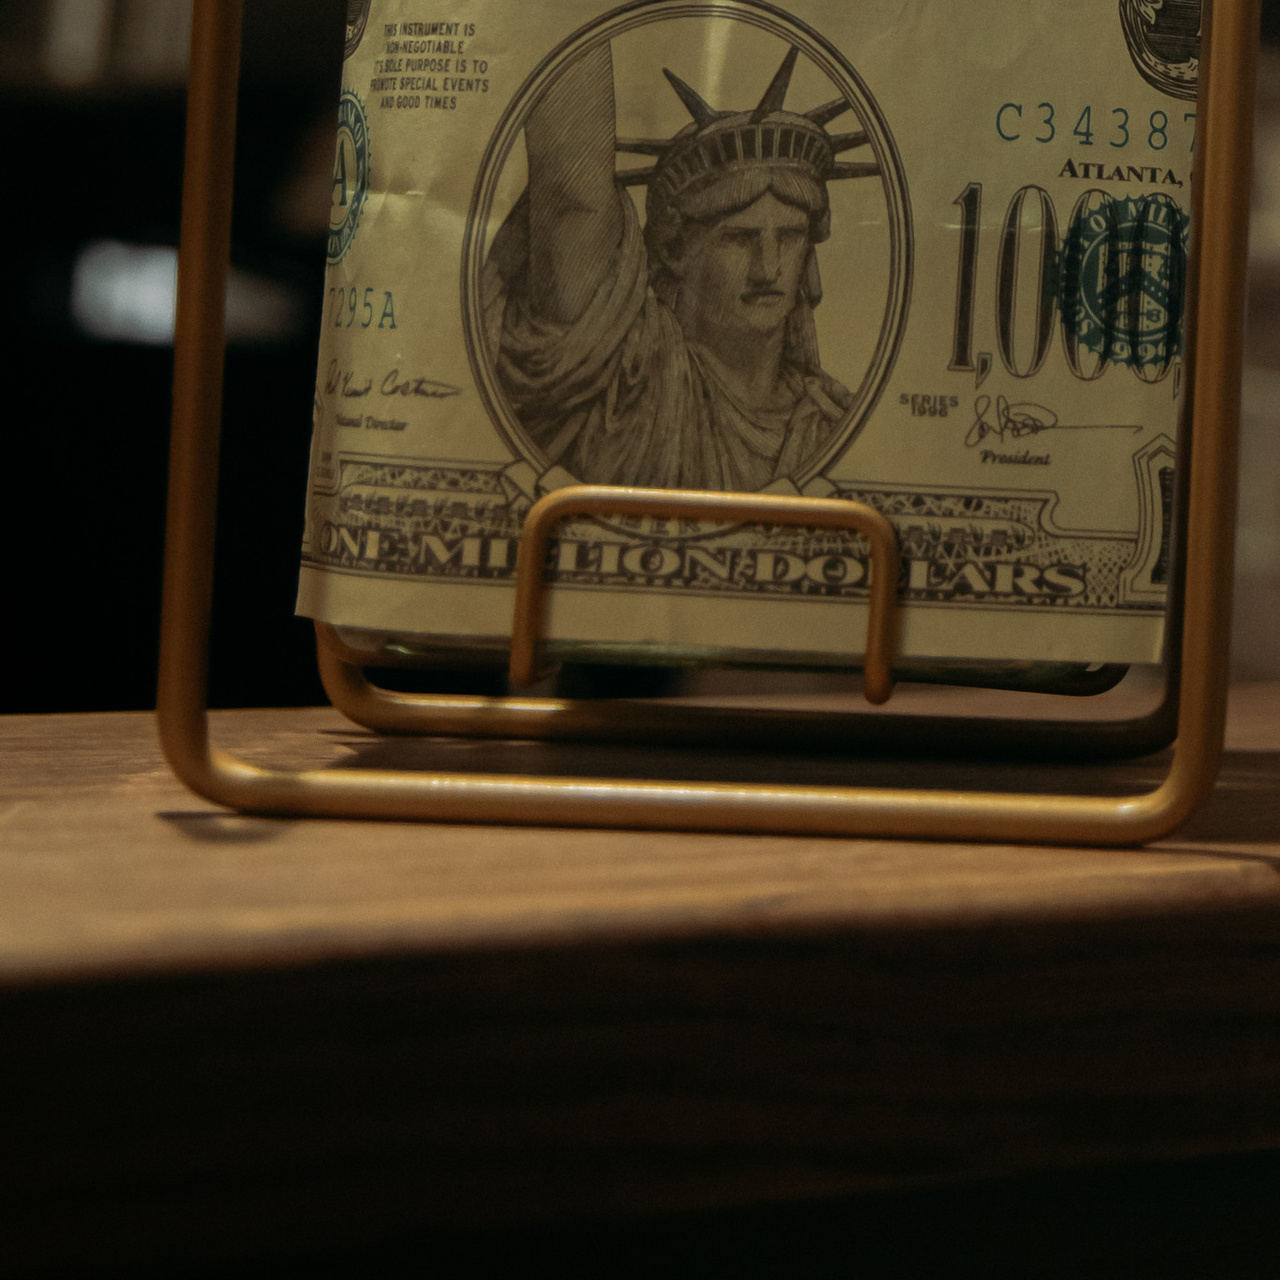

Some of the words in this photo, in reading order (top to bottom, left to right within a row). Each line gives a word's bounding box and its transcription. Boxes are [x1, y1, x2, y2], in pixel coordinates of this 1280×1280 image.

[384, 24, 398, 37] THIS
[400, 23, 459, 37] INSTRUMENT
[464, 23, 476, 37] IS
[386, 40, 464, 55] NON-NEGOTIABLE
[385, 59, 402, 74] SOLE
[405, 59, 451, 73] PURPOSE
[455, 59, 467, 73] IS
[473, 59, 488, 74] TO
[370, 77, 397, 93] PROMOTE
[399, 77, 438, 92] SPECIAL
[443, 77, 490, 93] EVENTS
[380, 96, 394, 110] AND
[396, 96, 421, 109] GOOD
[425, 96, 457, 110] TIMES
[996, 102, 1200, 154] C34387
[1059, 158, 1184, 188] ATLANTA,
[899, 392, 959, 409] SERIES
[980, 448, 1052, 467] President
[319, 521, 396, 563] ONE
[419, 535, 737, 582] MILION
[753, 548, 1088, 598] DOLARS
